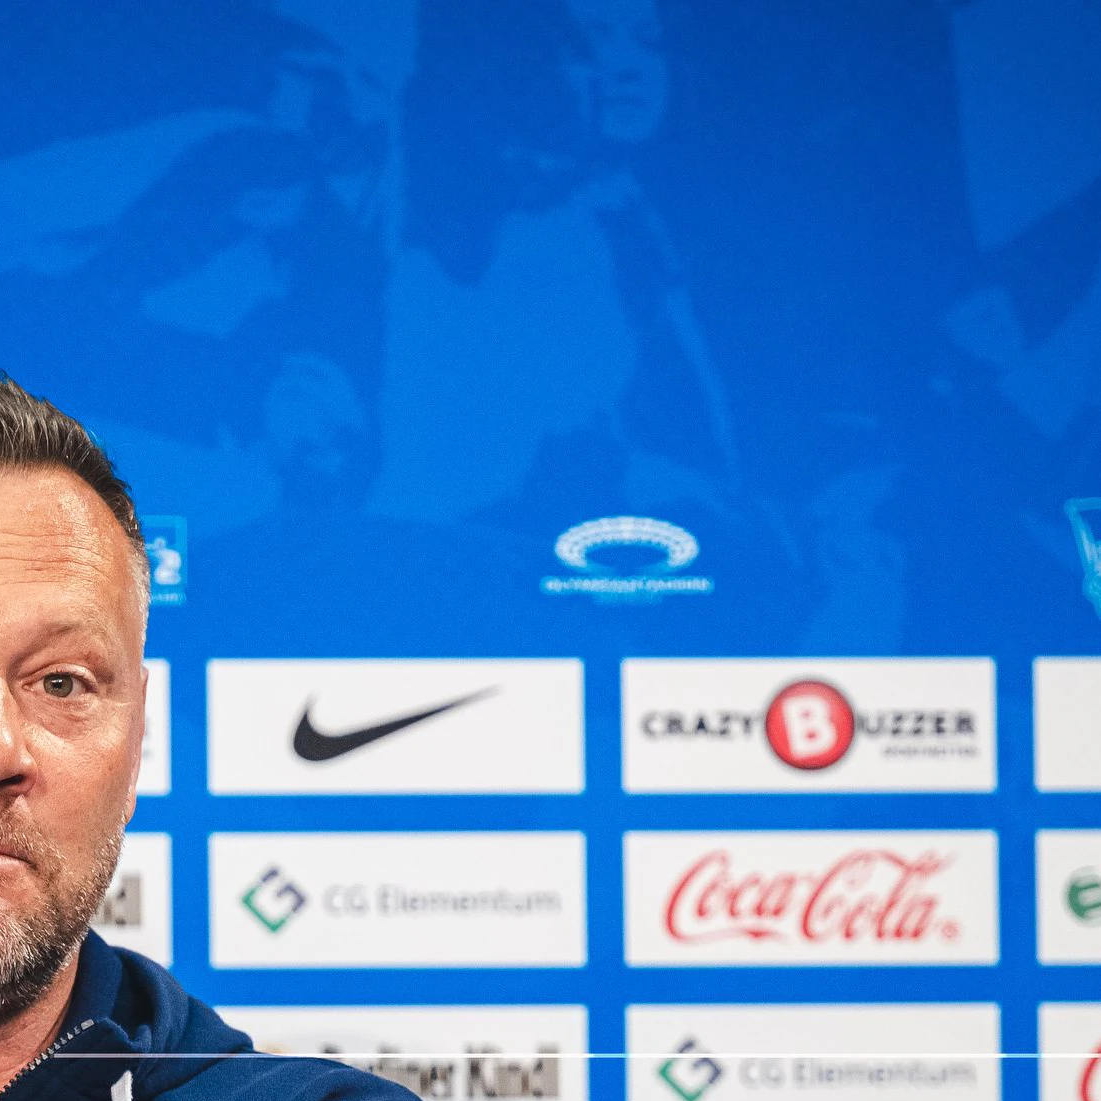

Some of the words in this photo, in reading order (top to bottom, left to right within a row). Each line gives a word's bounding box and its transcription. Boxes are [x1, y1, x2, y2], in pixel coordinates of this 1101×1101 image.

[641, 711, 756, 739] CRAZY
[321, 883, 371, 919] CG
[662, 850, 956, 944] Coca-Cola
